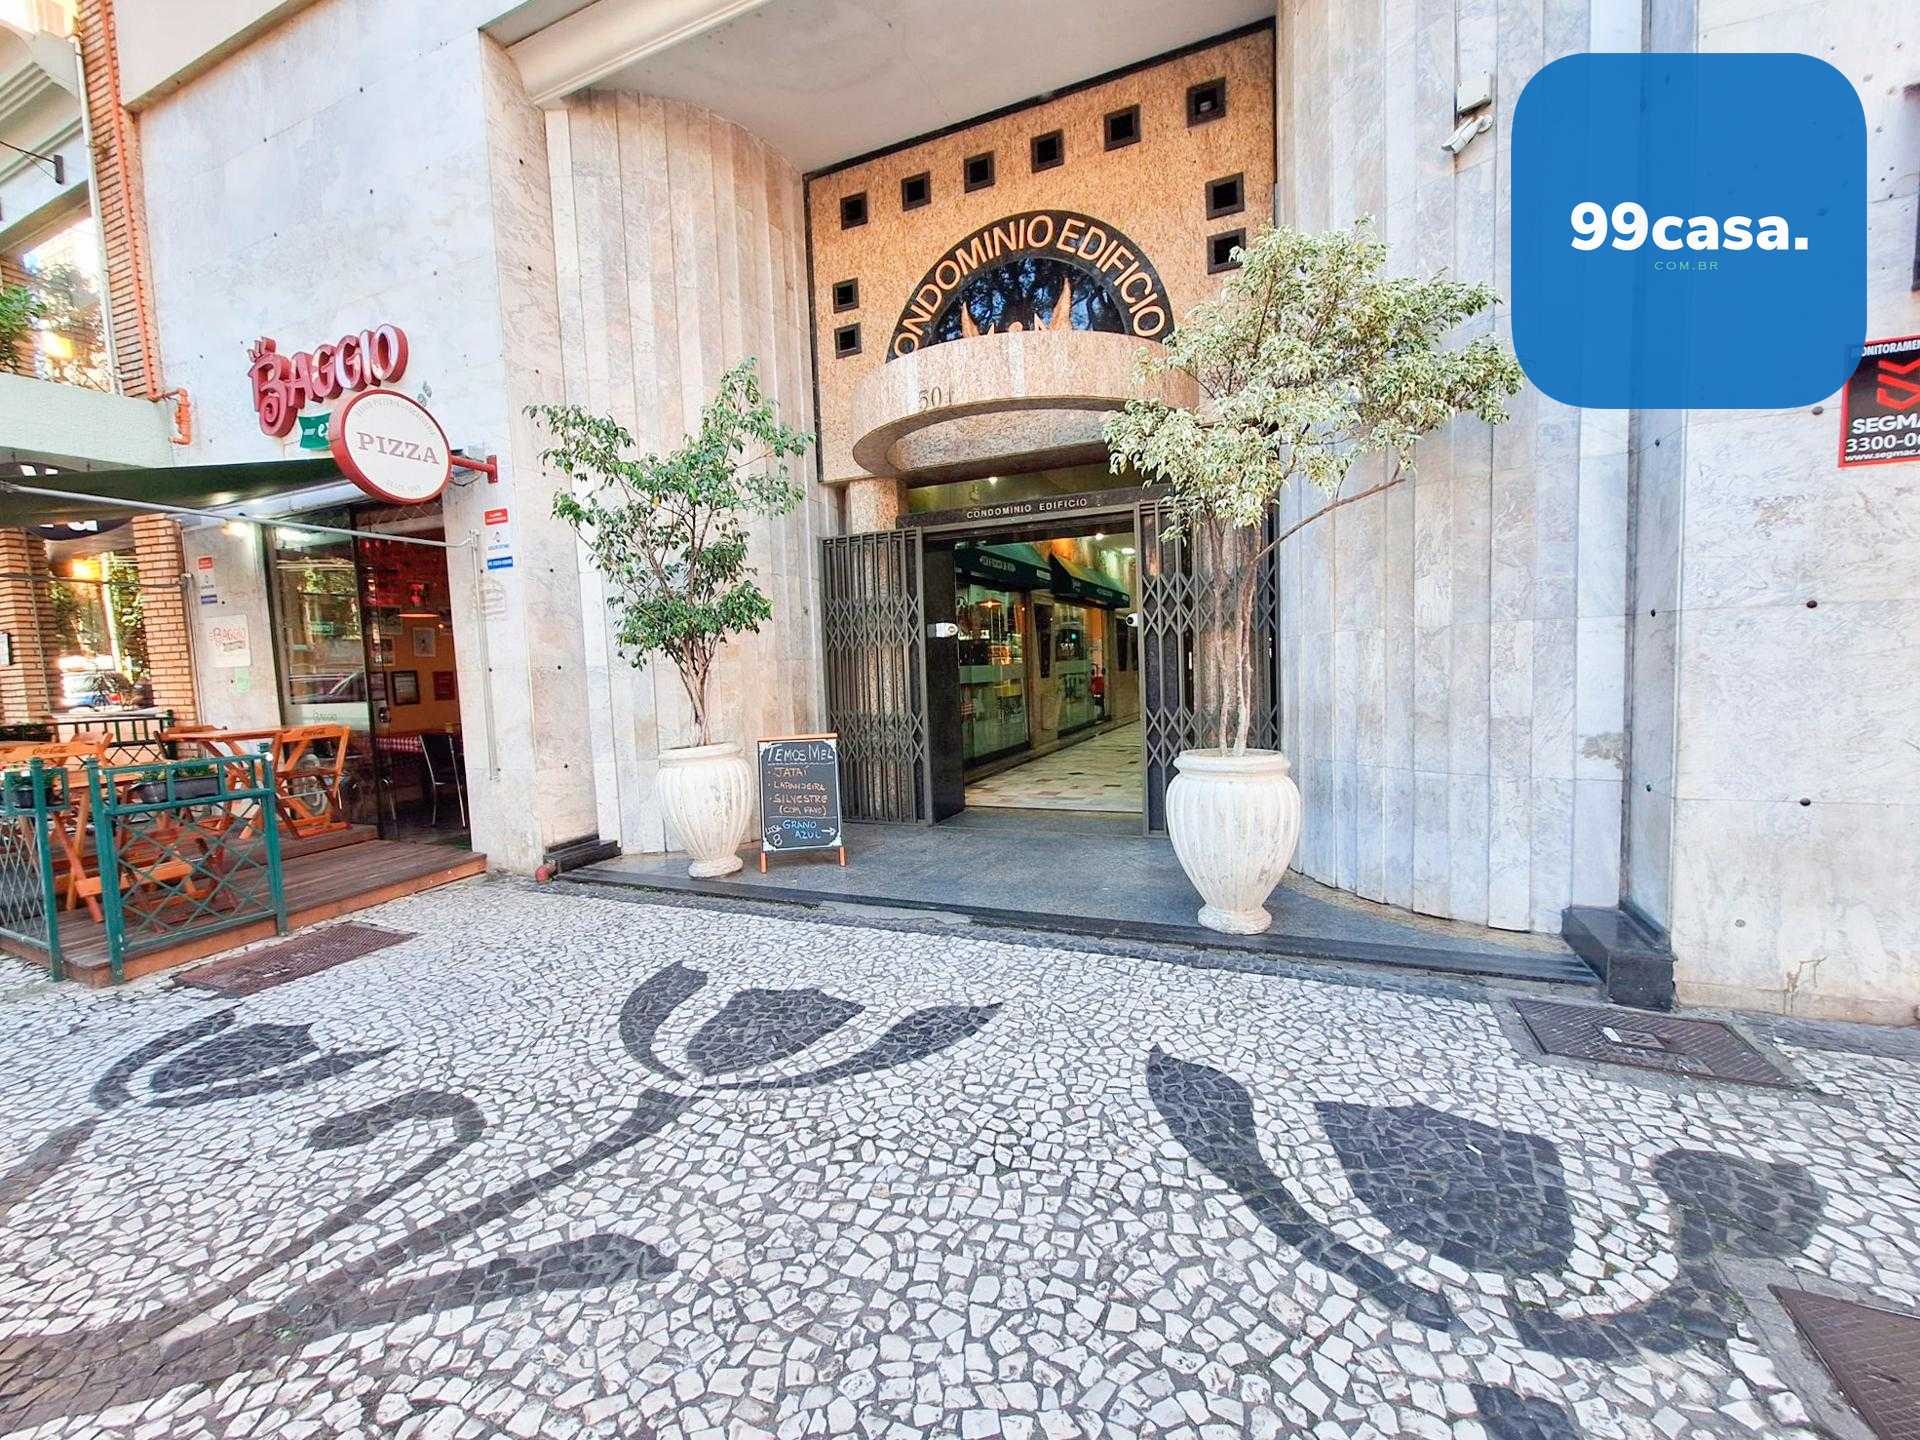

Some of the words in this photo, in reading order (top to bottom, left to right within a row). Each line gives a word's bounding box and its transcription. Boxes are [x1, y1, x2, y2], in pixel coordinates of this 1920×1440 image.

[893, 214, 1053, 357] ONDOMINIO
[1055, 217, 1166, 337] EDIFICIO
[248, 323, 409, 438] BAGGIO
[1852, 412, 1920, 435] SEGM
[356, 431, 440, 466] PIZZA
[1846, 432, 1920, 453] 3300-0
[966, 504, 1032, 519] CONDOMINIO
[1039, 498, 1088, 511] EDIFICIO
[765, 743, 806, 762] TEMOS
[808, 743, 834, 761] MEL
[773, 793, 828, 804] SILVESTRE
